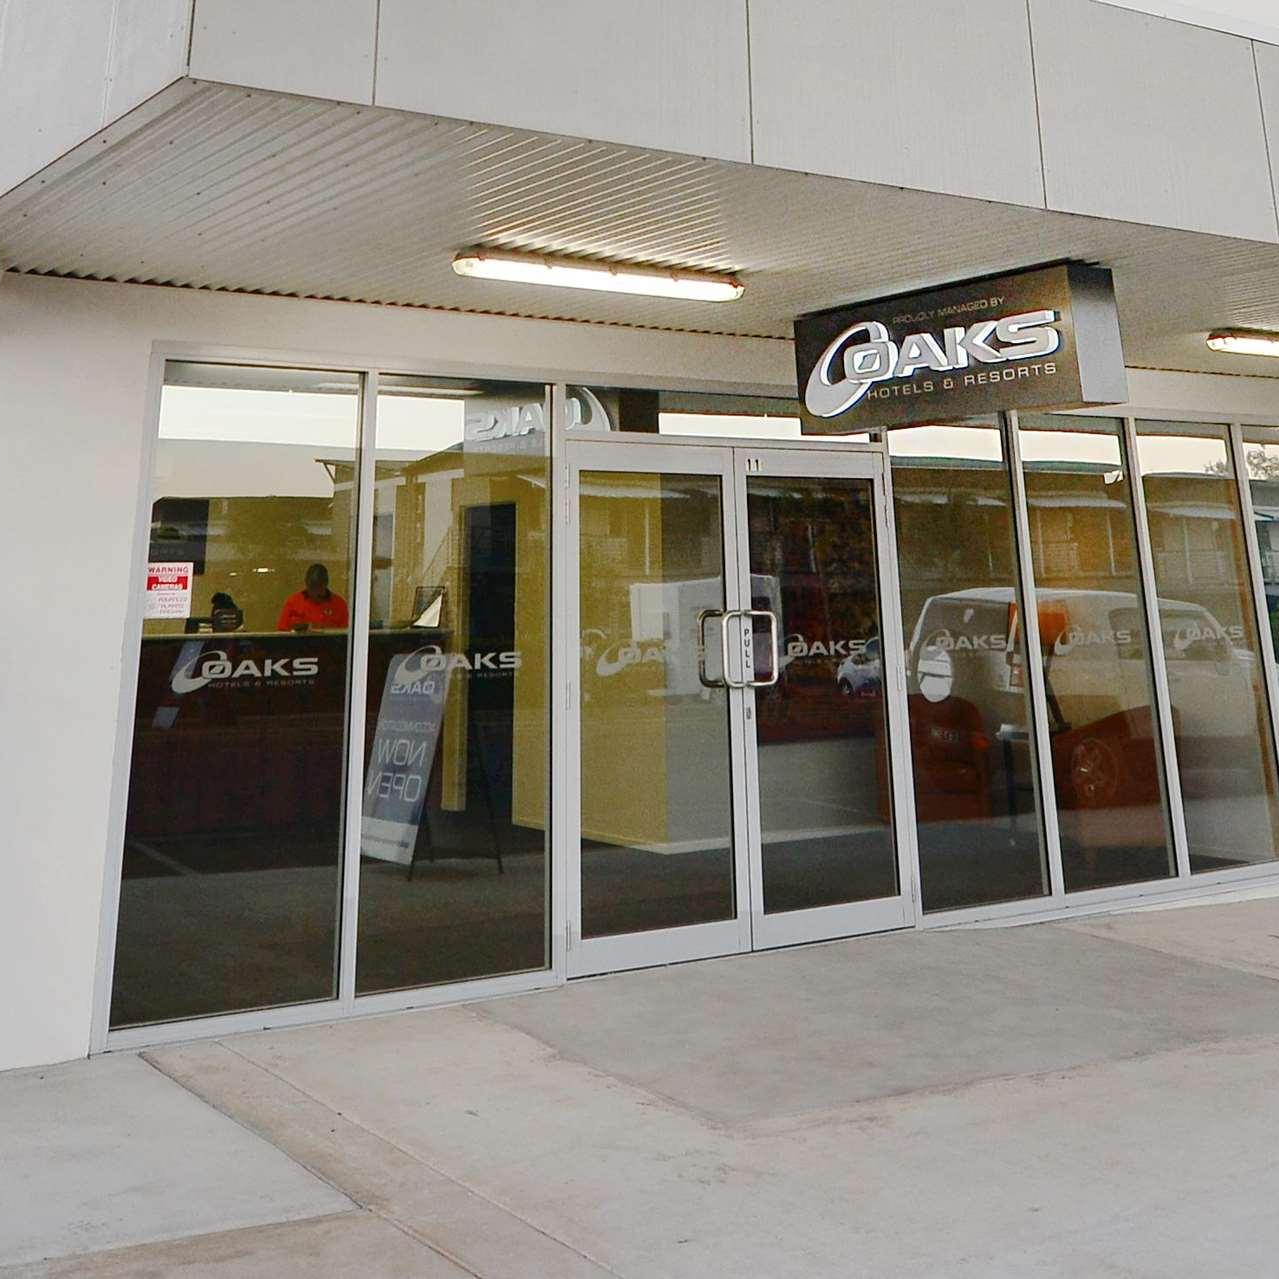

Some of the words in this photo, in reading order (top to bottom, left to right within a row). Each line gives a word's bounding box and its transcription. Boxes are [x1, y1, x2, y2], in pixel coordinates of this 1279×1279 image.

[937, 299, 989, 317] MANAGED
[990, 295, 1006, 308] BY
[842, 310, 1062, 384] OAKS
[868, 380, 934, 400] HOTELS
[964, 362, 1058, 386] RESORTS
[747, 458, 760, 473] 11
[147, 566, 189, 574] WARNING
[743, 628, 751, 669] PULL
[786, 640, 868, 658] OAKS
[935, 634, 1008, 651] OAKS
[201, 657, 319, 679] OAKS
[420, 651, 523, 671] OAKS
